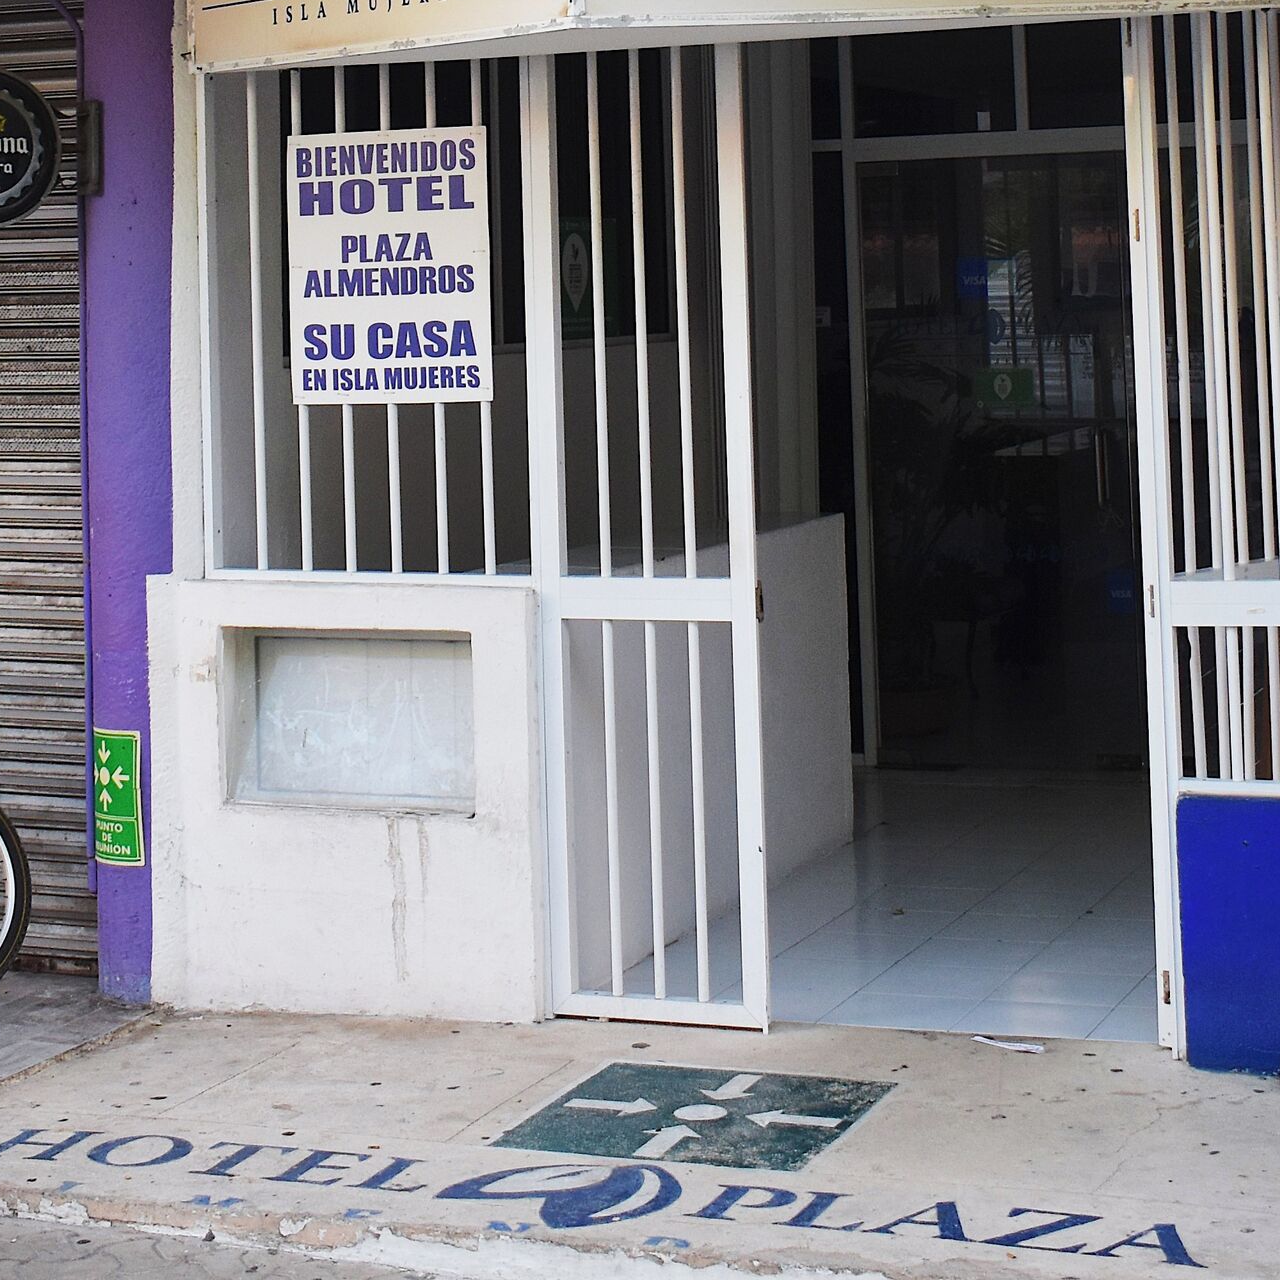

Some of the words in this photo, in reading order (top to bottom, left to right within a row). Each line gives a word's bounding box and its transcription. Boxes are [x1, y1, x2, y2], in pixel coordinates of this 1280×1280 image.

[272, 1, 327, 25] ISLA
[296, 139, 476, 178] BIENVENIDOS
[298, 174, 475, 217] HOTEL
[341, 232, 433, 264] PLAZA
[303, 264, 475, 299] ALMENDROS
[303, 323, 356, 361] SU
[367, 320, 477, 360] CASA
[302, 368, 327, 391] EN
[332, 367, 379, 391] ISLA
[384, 365, 481, 390] MUJERES
[102, 831, 113, 843] DE
[686, 1182, 1208, 1269] PLAZA
